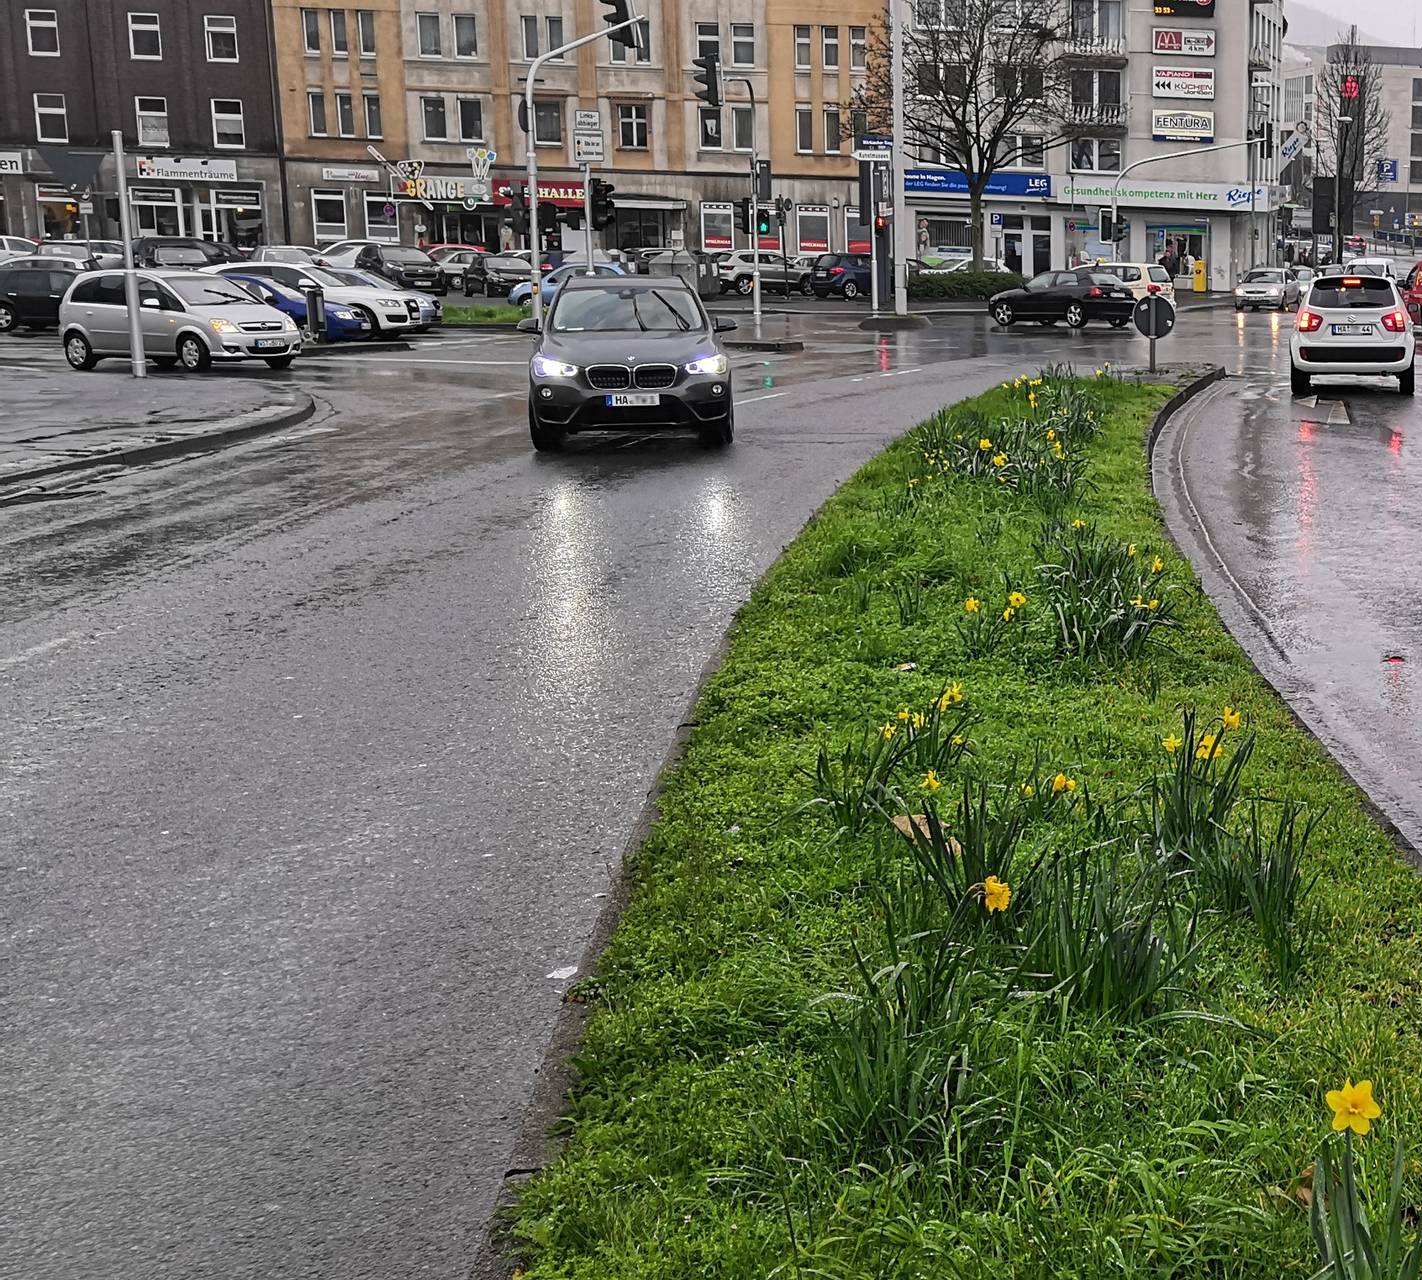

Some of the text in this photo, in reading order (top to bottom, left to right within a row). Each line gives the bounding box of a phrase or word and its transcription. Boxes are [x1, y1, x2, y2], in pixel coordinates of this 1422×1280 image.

[1174, 82, 1213, 90] KÜCHEN
[1383, 163, 1391, 172] P
[156, 168, 235, 180] Flammenträume
[1029, 178, 1047, 187] LEG
[1063, 185, 1218, 201] Gesundheitskompetenz mit Herz
[993, 214, 1000, 223] P
[615, 395, 628, 405] HA
